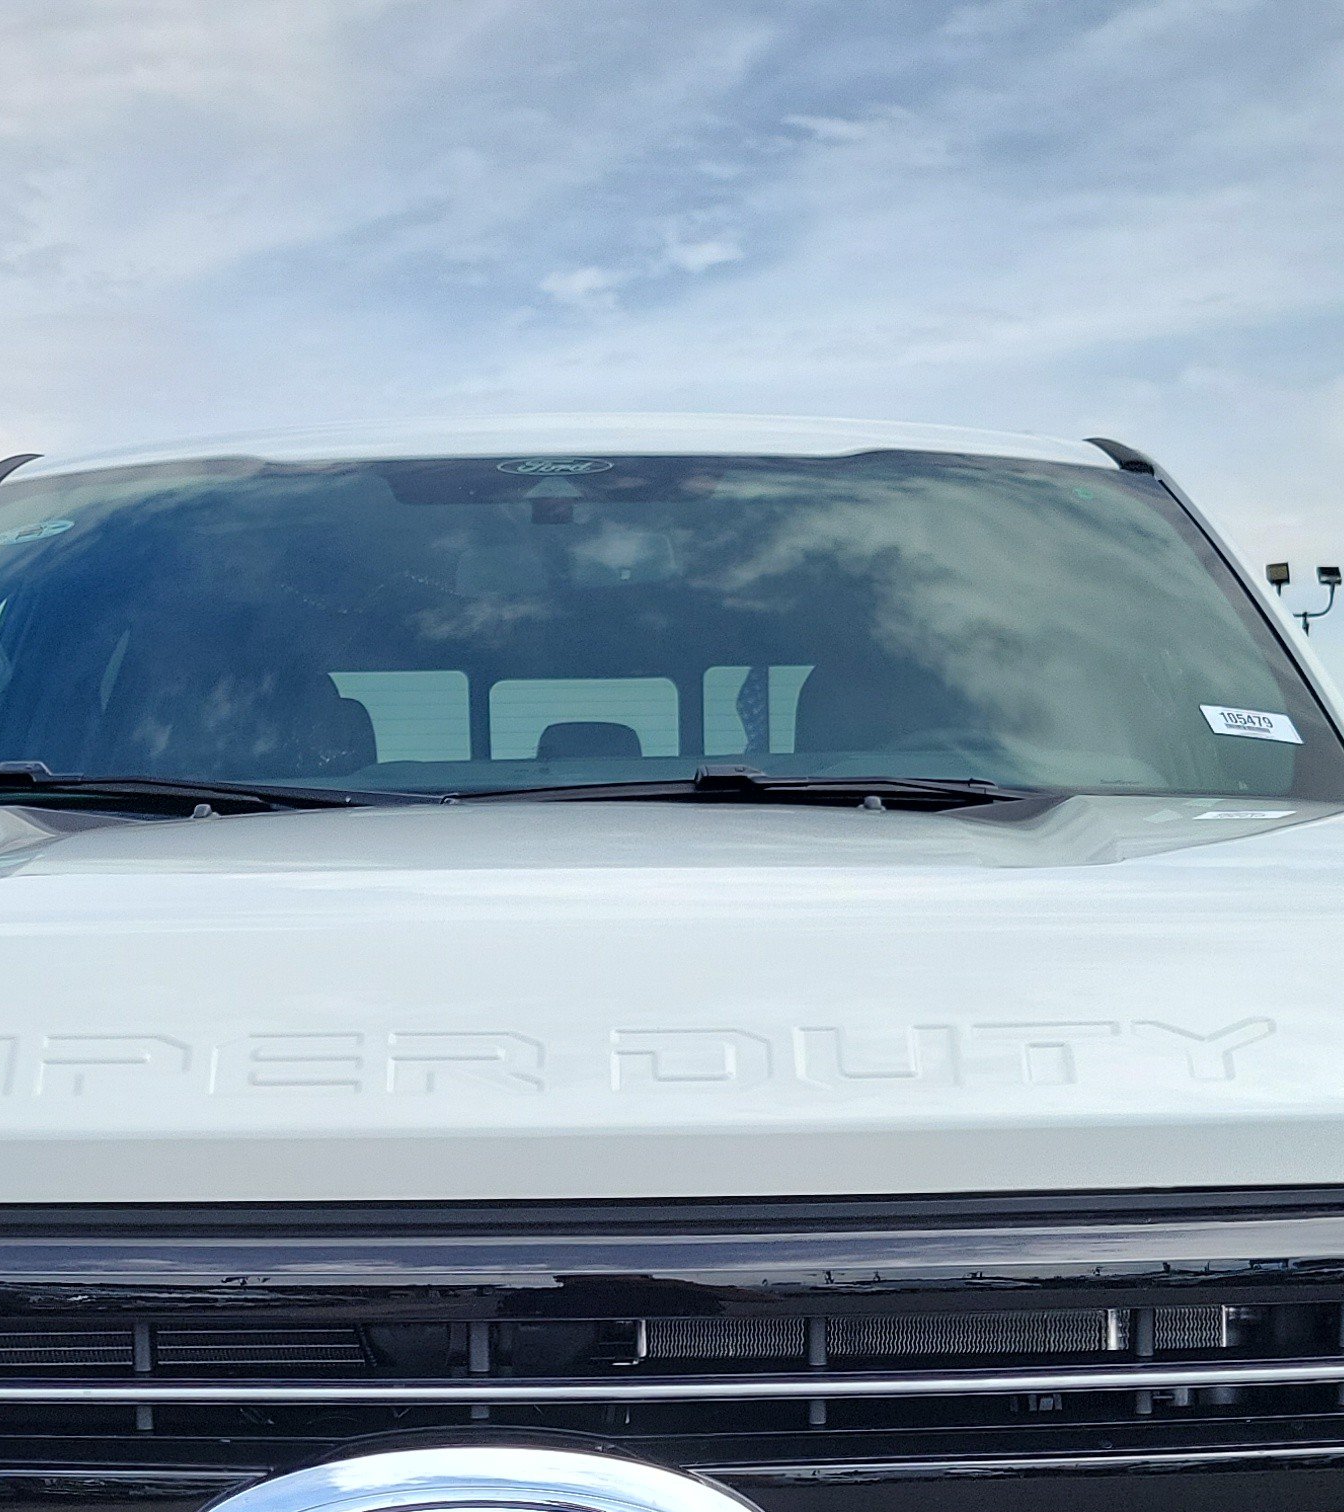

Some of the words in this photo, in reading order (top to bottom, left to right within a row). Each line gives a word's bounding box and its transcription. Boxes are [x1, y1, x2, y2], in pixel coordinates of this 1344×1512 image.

[516, 460, 594, 473] Ford
[1219, 711, 1274, 729] 105479
[609, 1017, 1278, 1091] DUTY
